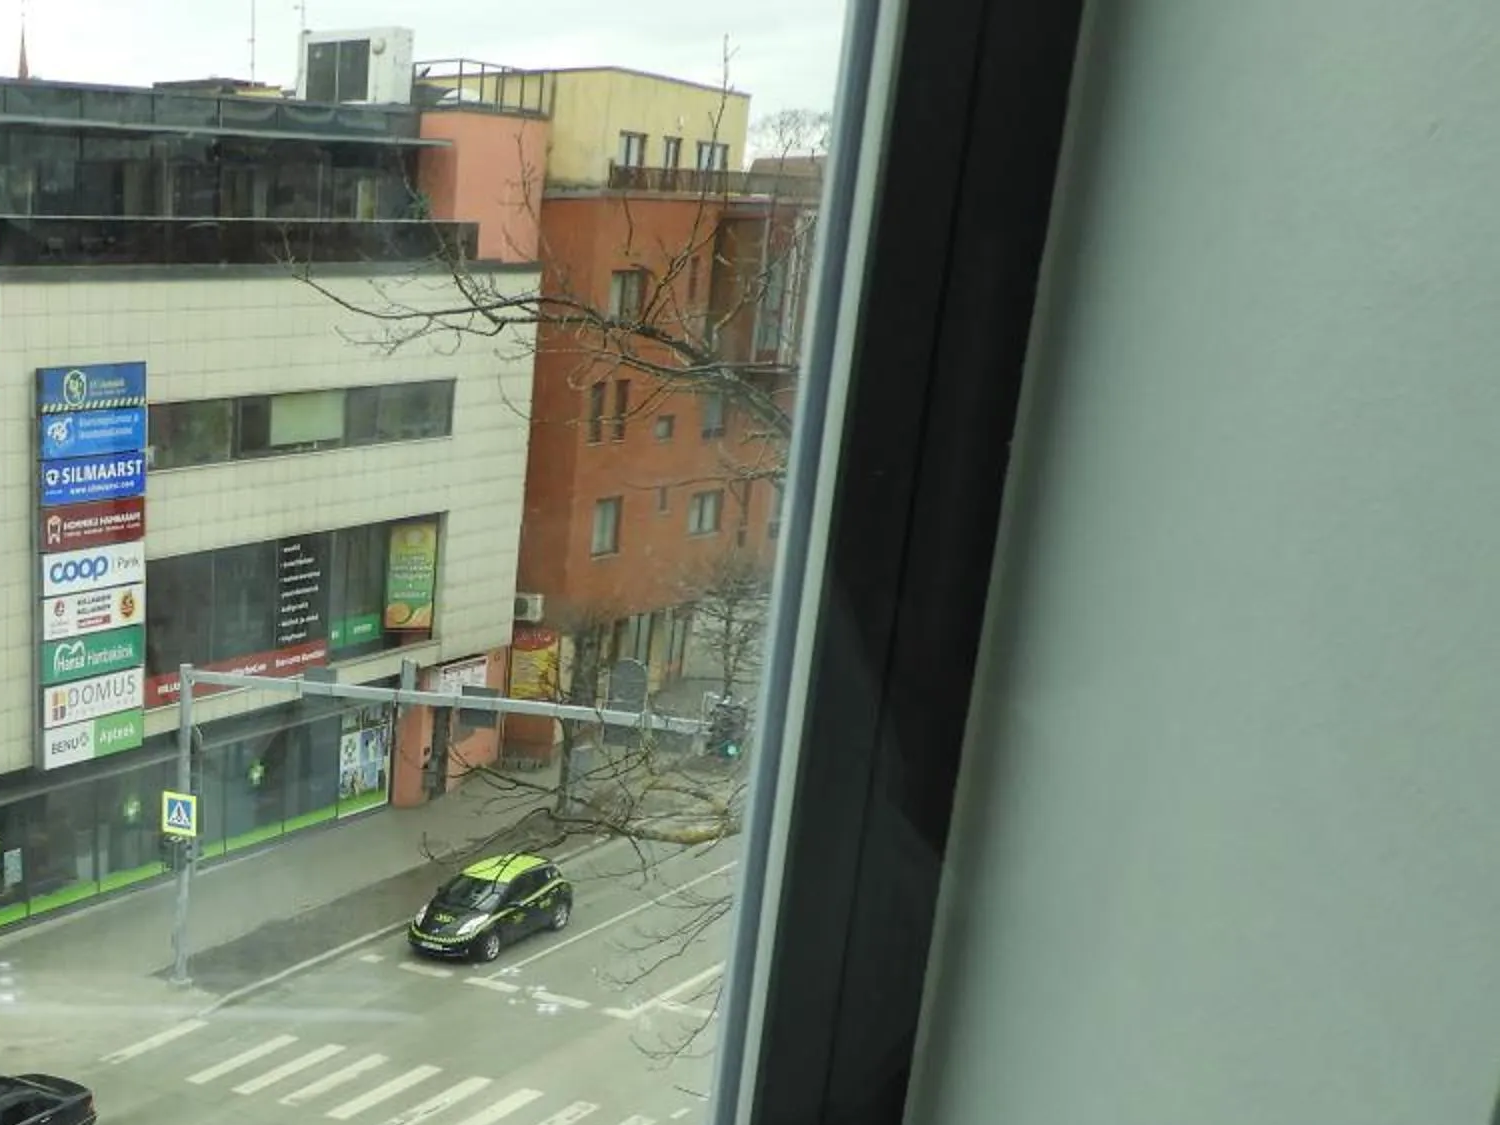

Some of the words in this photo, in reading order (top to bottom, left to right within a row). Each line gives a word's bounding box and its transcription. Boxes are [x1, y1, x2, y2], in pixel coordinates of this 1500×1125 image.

[62, 460, 143, 485] SILMAARST
[50, 555, 108, 584] coop
[68, 674, 136, 702] DOMUS
[52, 736, 79, 755] BENU
